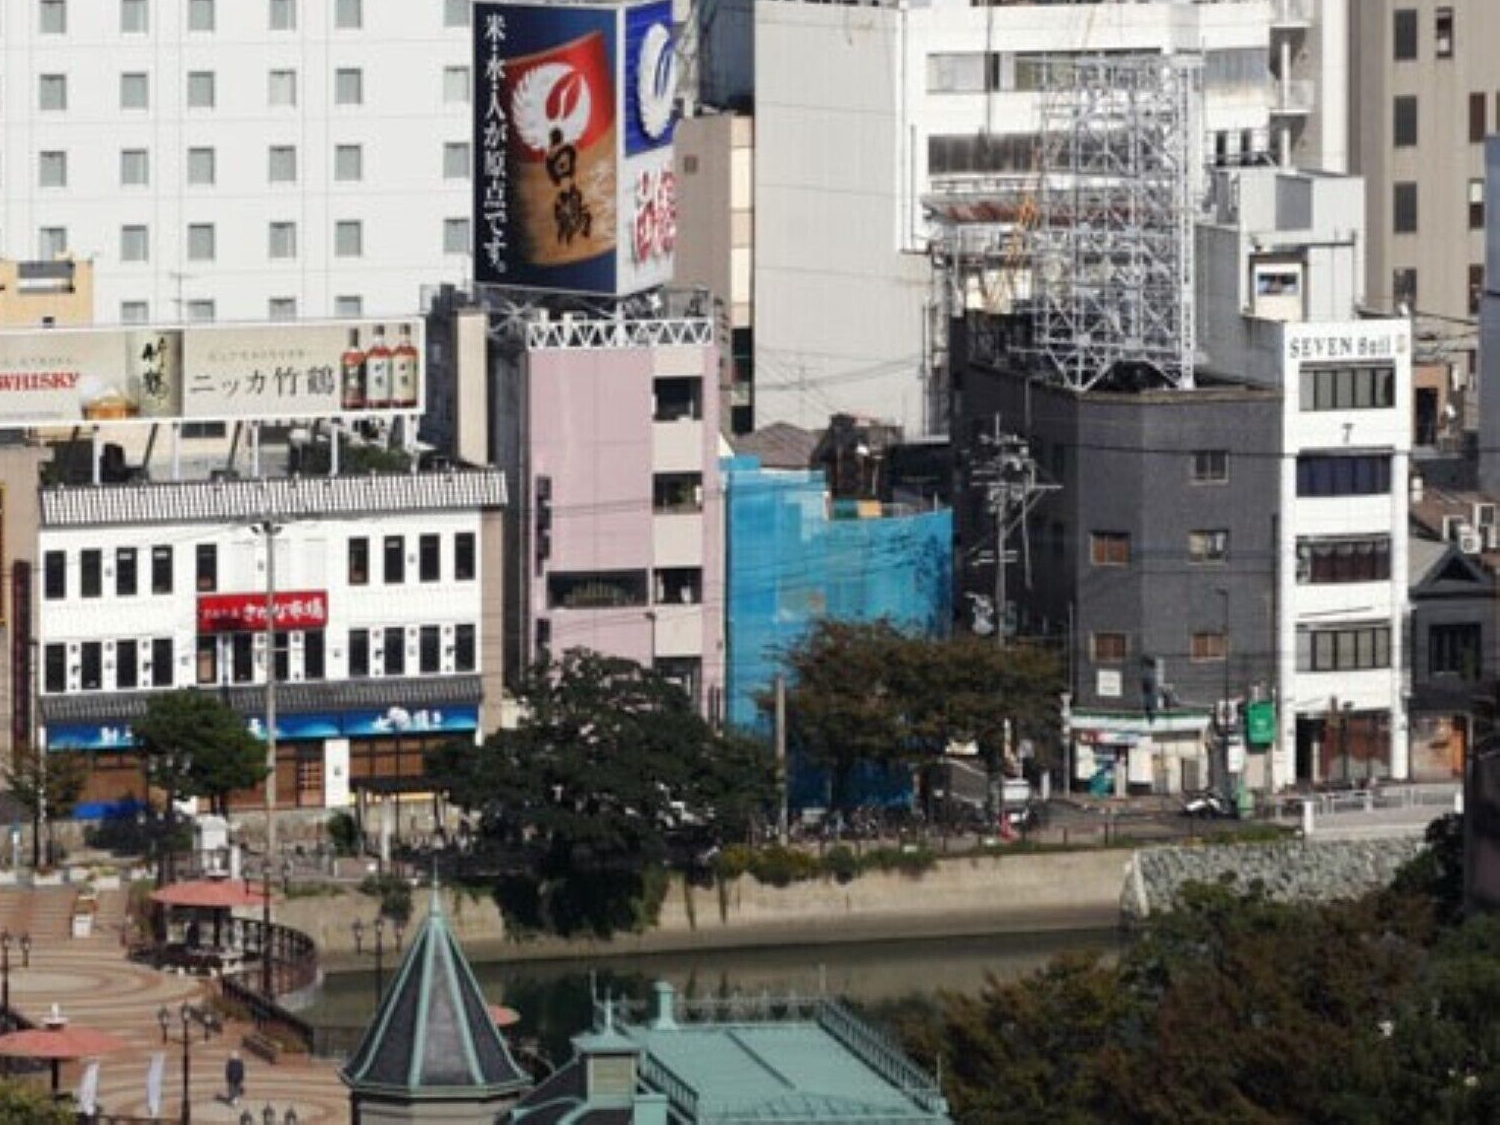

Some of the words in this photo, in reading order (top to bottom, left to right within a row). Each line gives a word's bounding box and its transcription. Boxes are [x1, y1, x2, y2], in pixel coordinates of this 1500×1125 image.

[1289, 336, 1352, 359] SEVEN
[190, 365, 334, 397] ニッカ竹鶴
